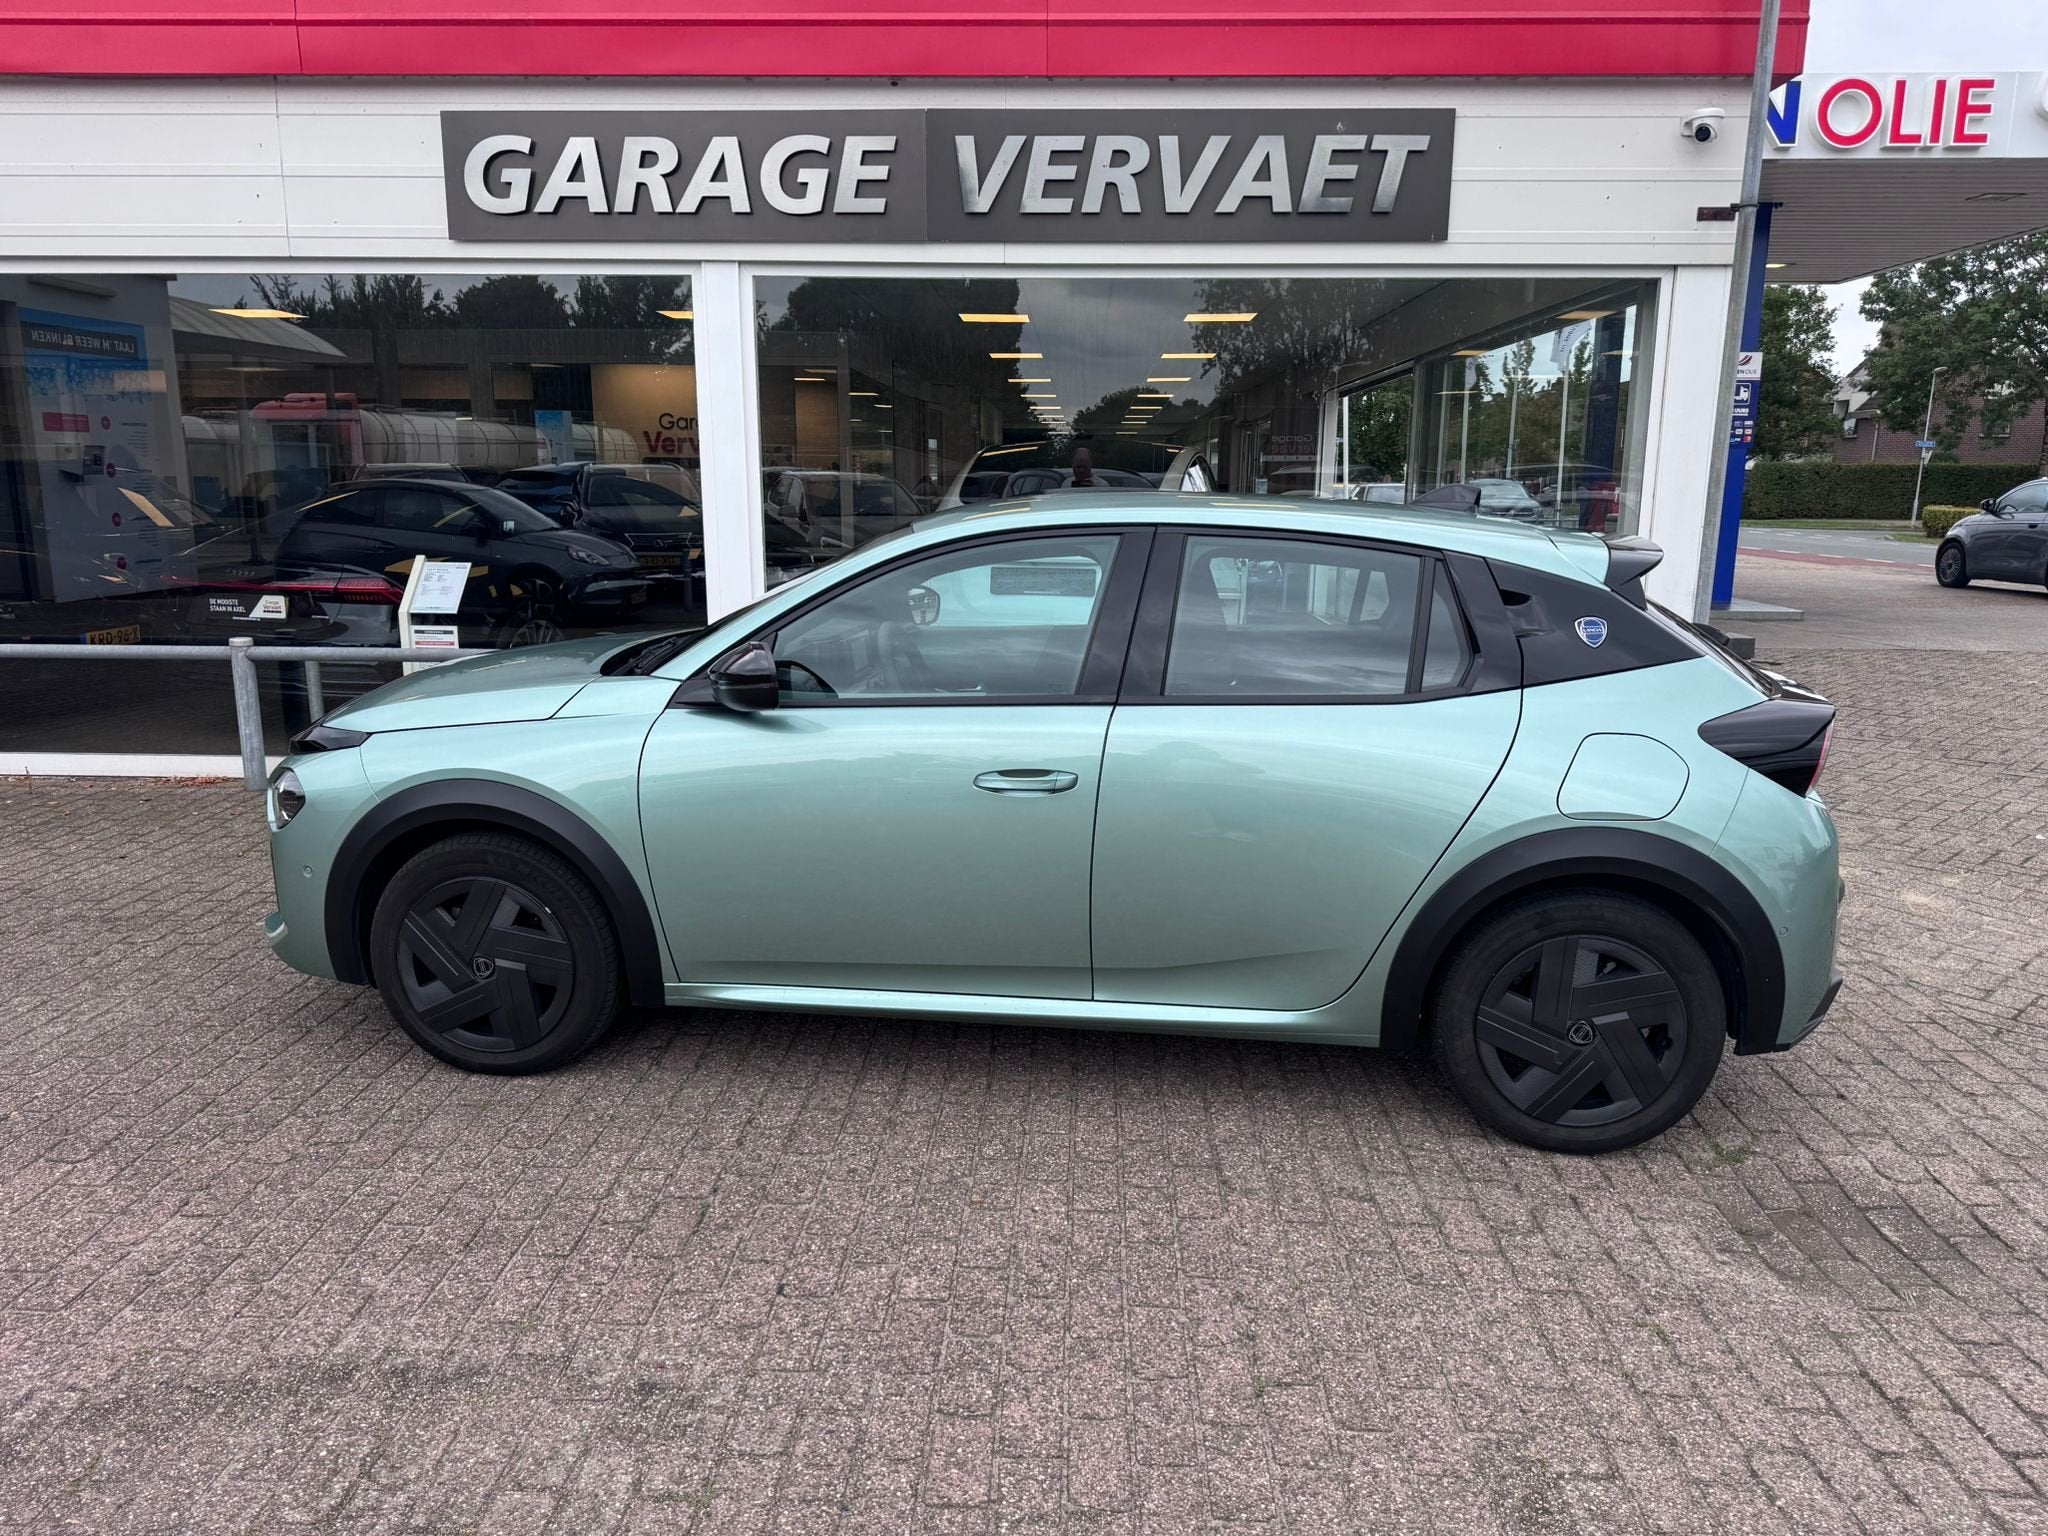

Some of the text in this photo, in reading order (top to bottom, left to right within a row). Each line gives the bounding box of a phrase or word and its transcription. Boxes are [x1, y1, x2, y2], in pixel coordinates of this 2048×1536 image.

[463, 133, 1432, 216] GARAGE VERVAET
[658, 412, 699, 430] Gar
